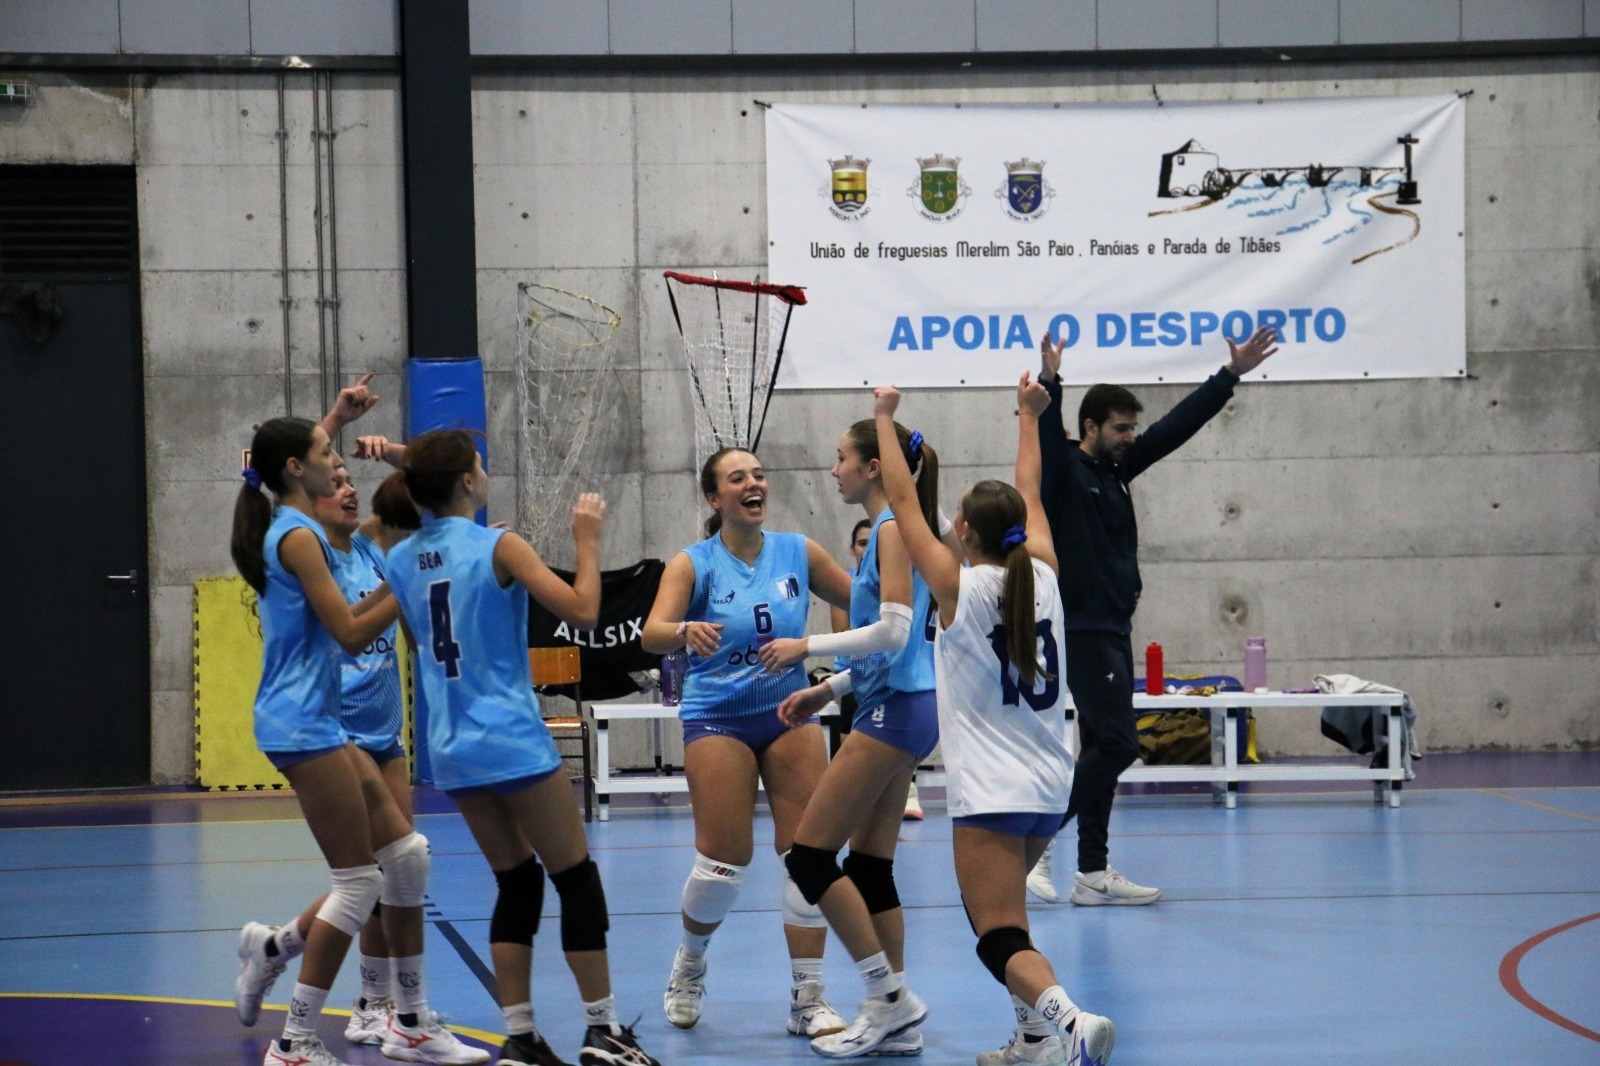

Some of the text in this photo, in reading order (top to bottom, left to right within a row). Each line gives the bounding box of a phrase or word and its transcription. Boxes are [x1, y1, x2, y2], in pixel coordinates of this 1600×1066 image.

[810, 242, 846, 259] União
[853, 241, 870, 258] de
[877, 241, 948, 262] freguesias
[957, 240, 1010, 258] Merelim
[1017, 239, 1041, 257] São
[1048, 239, 1074, 256] Paio
[1090, 239, 1139, 256] Panóias
[1147, 243, 1156, 255] e
[1163, 238, 1207, 255] Parada
[1216, 238, 1231, 254] de
[1239, 236, 1281, 254] Tibães
[887, 307, 1346, 352] APOIA O DESPORTO
[418, 551, 443, 571] BEA
[429, 578, 463, 680] 4
[553, 616, 643, 649] ALLSIX
[752, 603, 773, 635] 6
